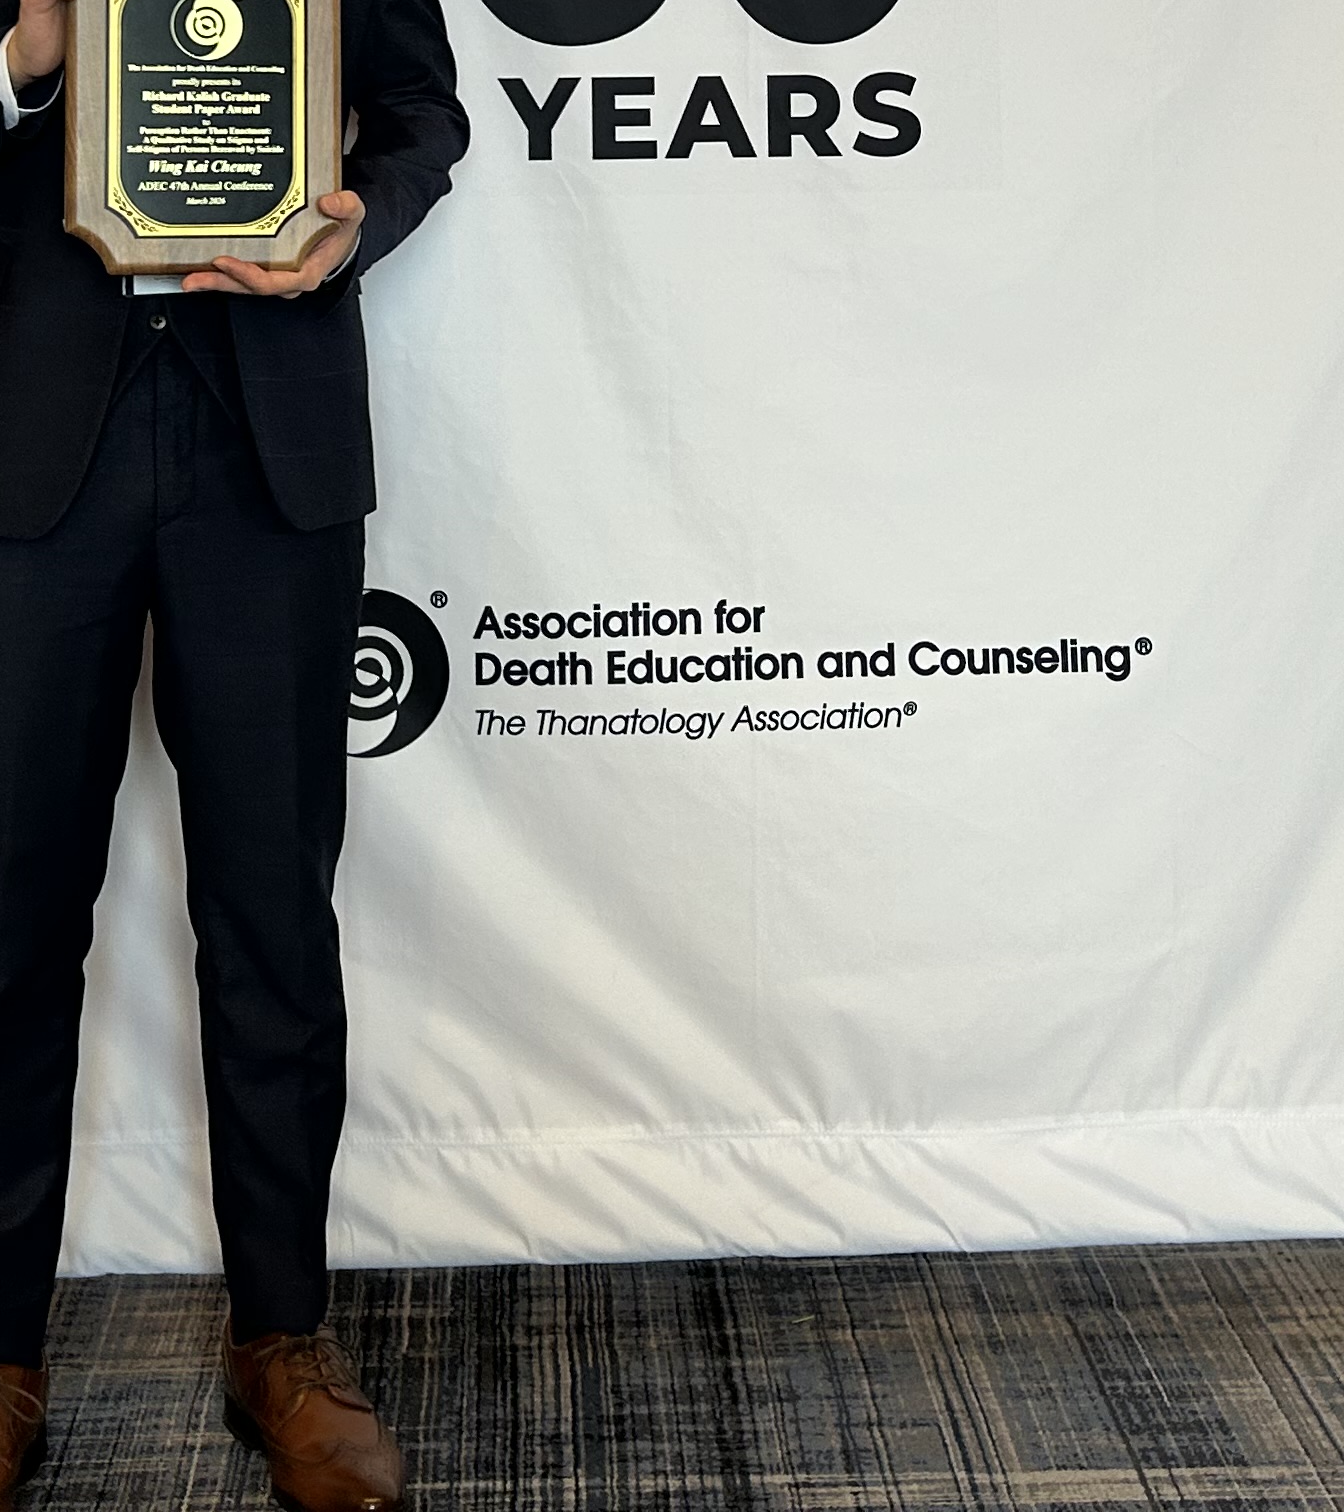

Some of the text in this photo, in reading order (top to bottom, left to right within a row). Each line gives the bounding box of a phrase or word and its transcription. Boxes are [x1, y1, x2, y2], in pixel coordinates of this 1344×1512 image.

[142, 91, 271, 102] Richard Kalish Graduate
[151, 104, 261, 116] Student Paper Award
[497, 72, 921, 161] YEARS
[149, 160, 262, 175] Wing Kai Cheung
[138, 181, 274, 191] ADEC 47th Annual Conference
[473, 599, 765, 640] Association for
[475, 652, 592, 686] Death
[607, 646, 804, 685] Education
[817, 642, 895, 679] and
[475, 710, 526, 736] The
[536, 708, 725, 740] Thanatology
